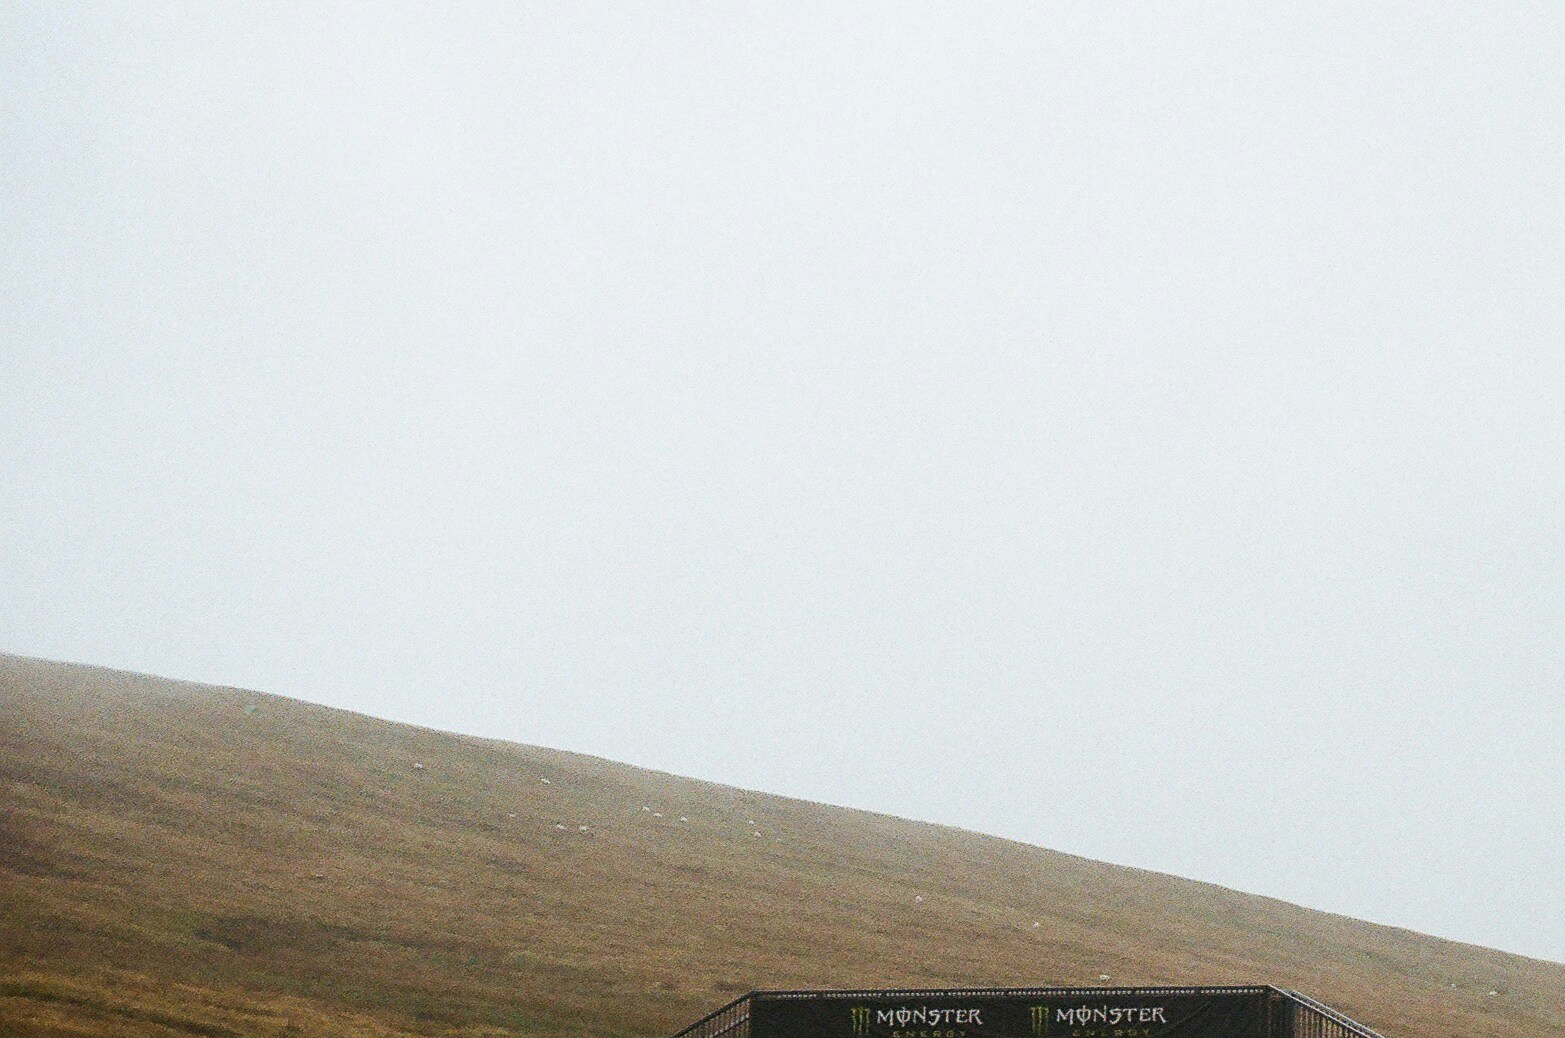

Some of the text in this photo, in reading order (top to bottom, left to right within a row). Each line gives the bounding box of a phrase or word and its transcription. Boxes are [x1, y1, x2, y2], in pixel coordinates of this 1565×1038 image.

[876, 1006, 983, 1027] MONSTER
[1056, 1005, 1167, 1026] MONSTER
[892, 1030, 966, 1038] ENERGY
